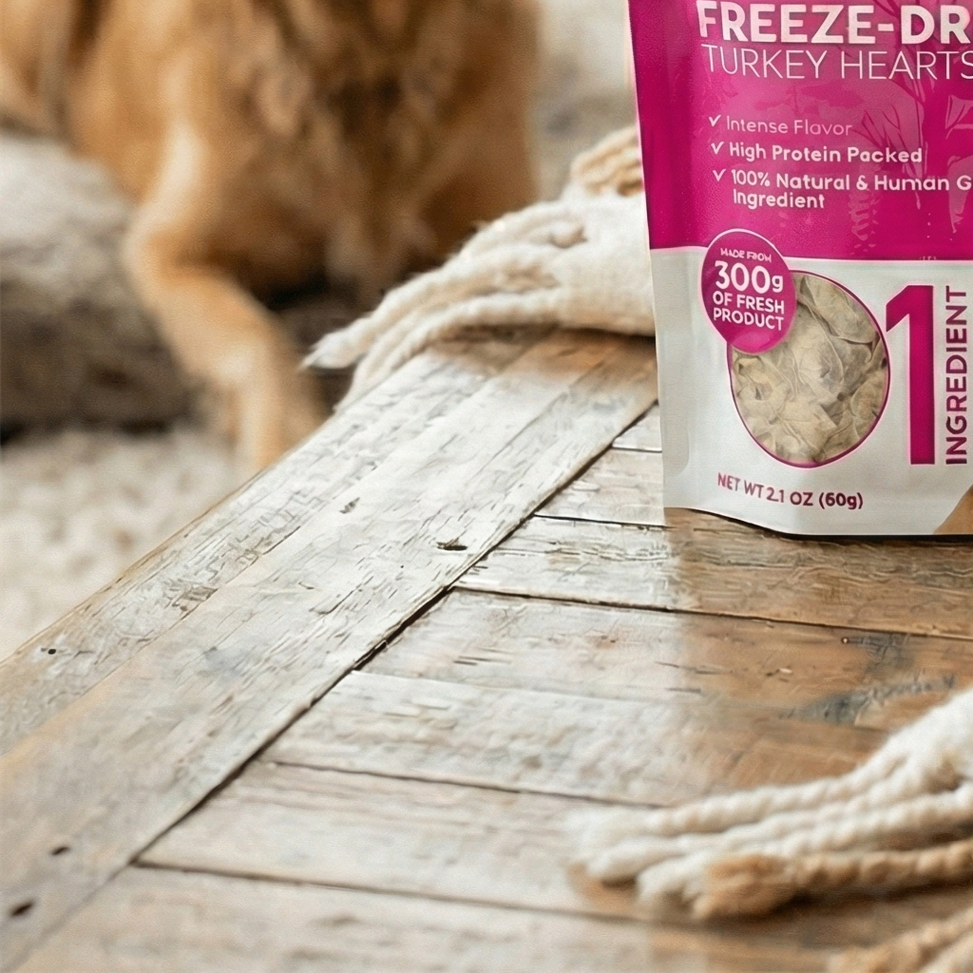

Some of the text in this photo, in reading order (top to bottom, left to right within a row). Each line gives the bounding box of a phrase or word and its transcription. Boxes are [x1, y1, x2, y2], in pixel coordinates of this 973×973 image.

[701, 43, 828, 79] TURKEY
[726, 115, 853, 136] Intense Flavor
[729, 142, 923, 164] High Protein Packed
[731, 169, 771, 187] 100%
[776, 173, 851, 191] Natural
[856, 176, 868, 191] &
[874, 175, 950, 192] Human
[732, 189, 825, 210] Ingredient
[720, 248, 744, 259] MADE
[714, 260, 783, 294] 300g
[712, 291, 784, 315] OF FRESH
[713, 307, 784, 331] PRODUCT
[886, 284, 936, 465] 1
[946, 285, 968, 465] INGREDIENT
[717, 472, 863, 509] NET WT 2.1 OZ (60g)
